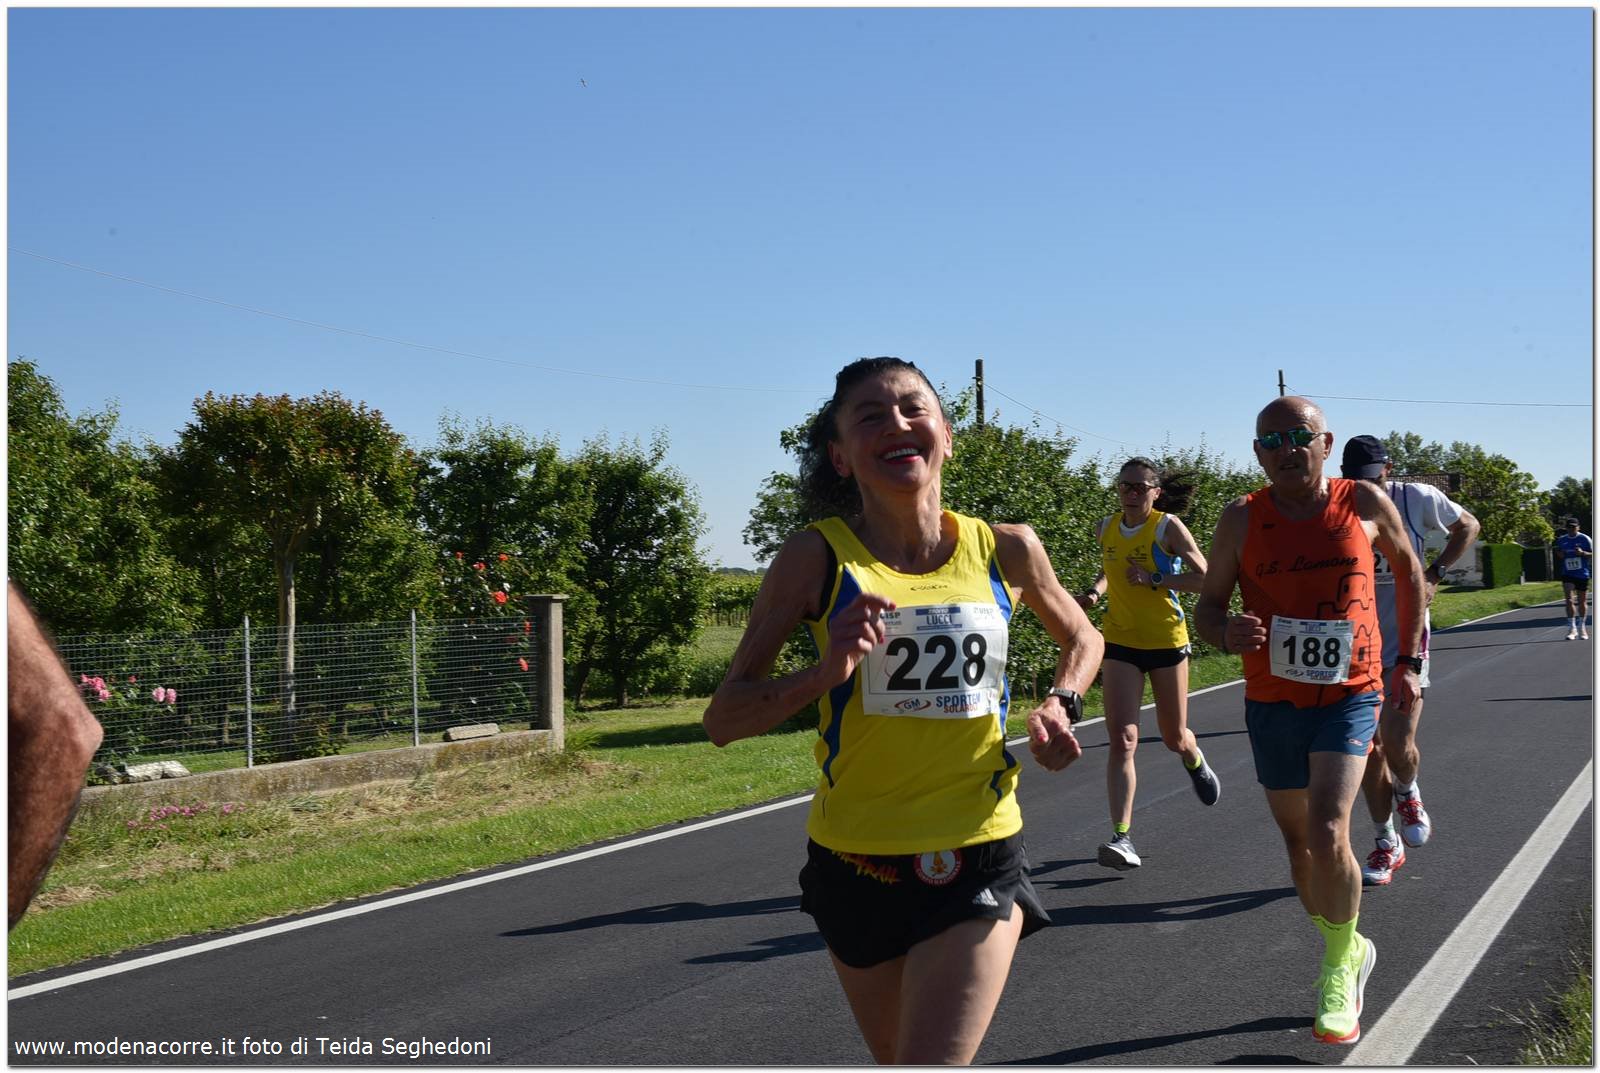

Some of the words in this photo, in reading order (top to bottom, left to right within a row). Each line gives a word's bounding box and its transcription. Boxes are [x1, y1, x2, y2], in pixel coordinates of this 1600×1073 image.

[1287, 555, 1358, 573] Lamone
[926, 614, 953, 625] LUCCI
[1283, 636, 1341, 668] 188
[886, 633, 987, 691] 228
[904, 698, 921, 710] GM
